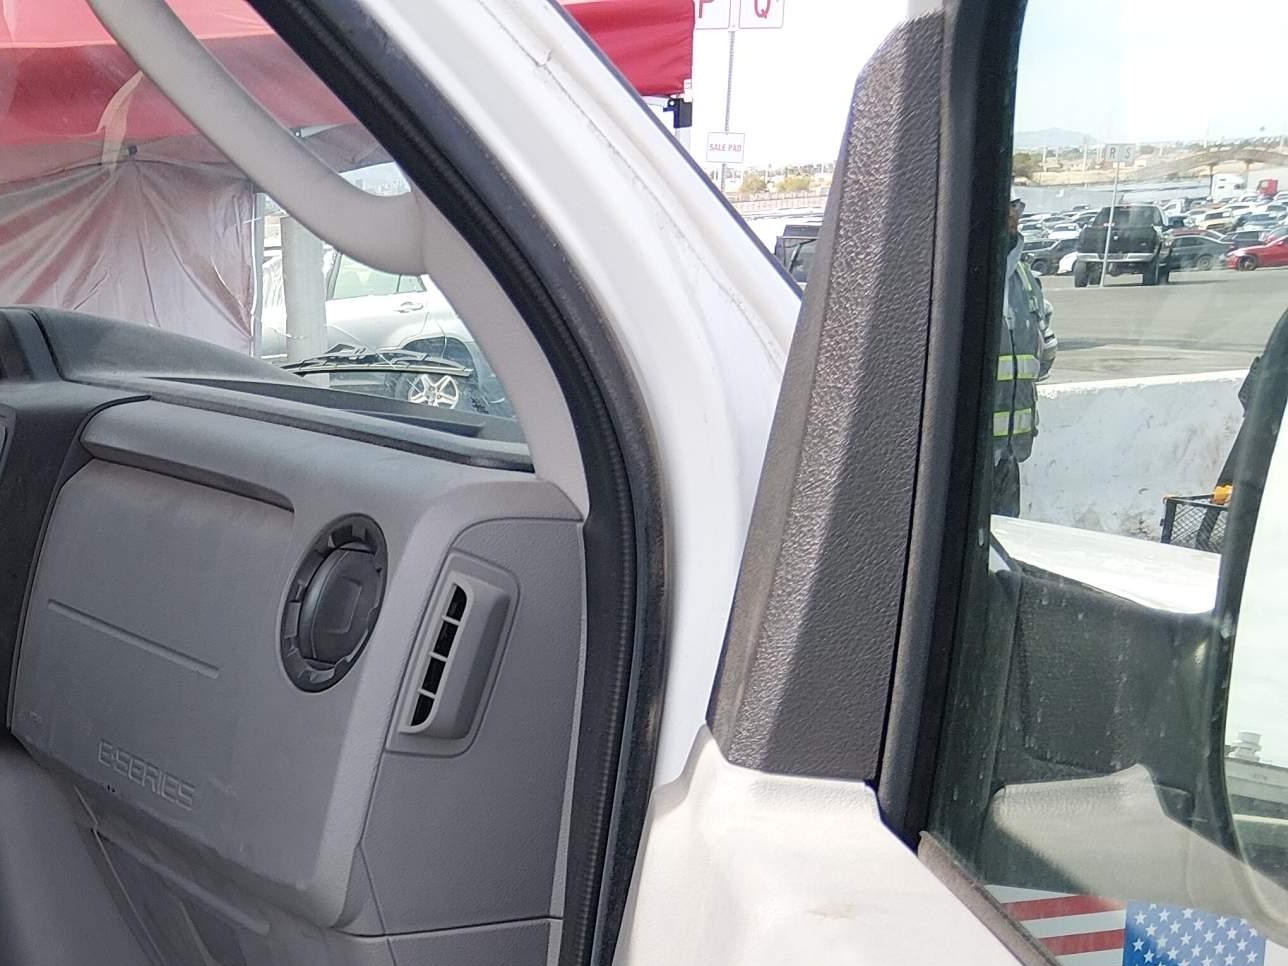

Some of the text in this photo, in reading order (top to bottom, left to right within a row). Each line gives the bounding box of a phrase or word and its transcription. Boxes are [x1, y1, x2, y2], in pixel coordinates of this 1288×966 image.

[709, 143, 726, 152] SALE
[1109, 146, 1116, 159] R
[97, 738, 196, 812] E-SERIES
